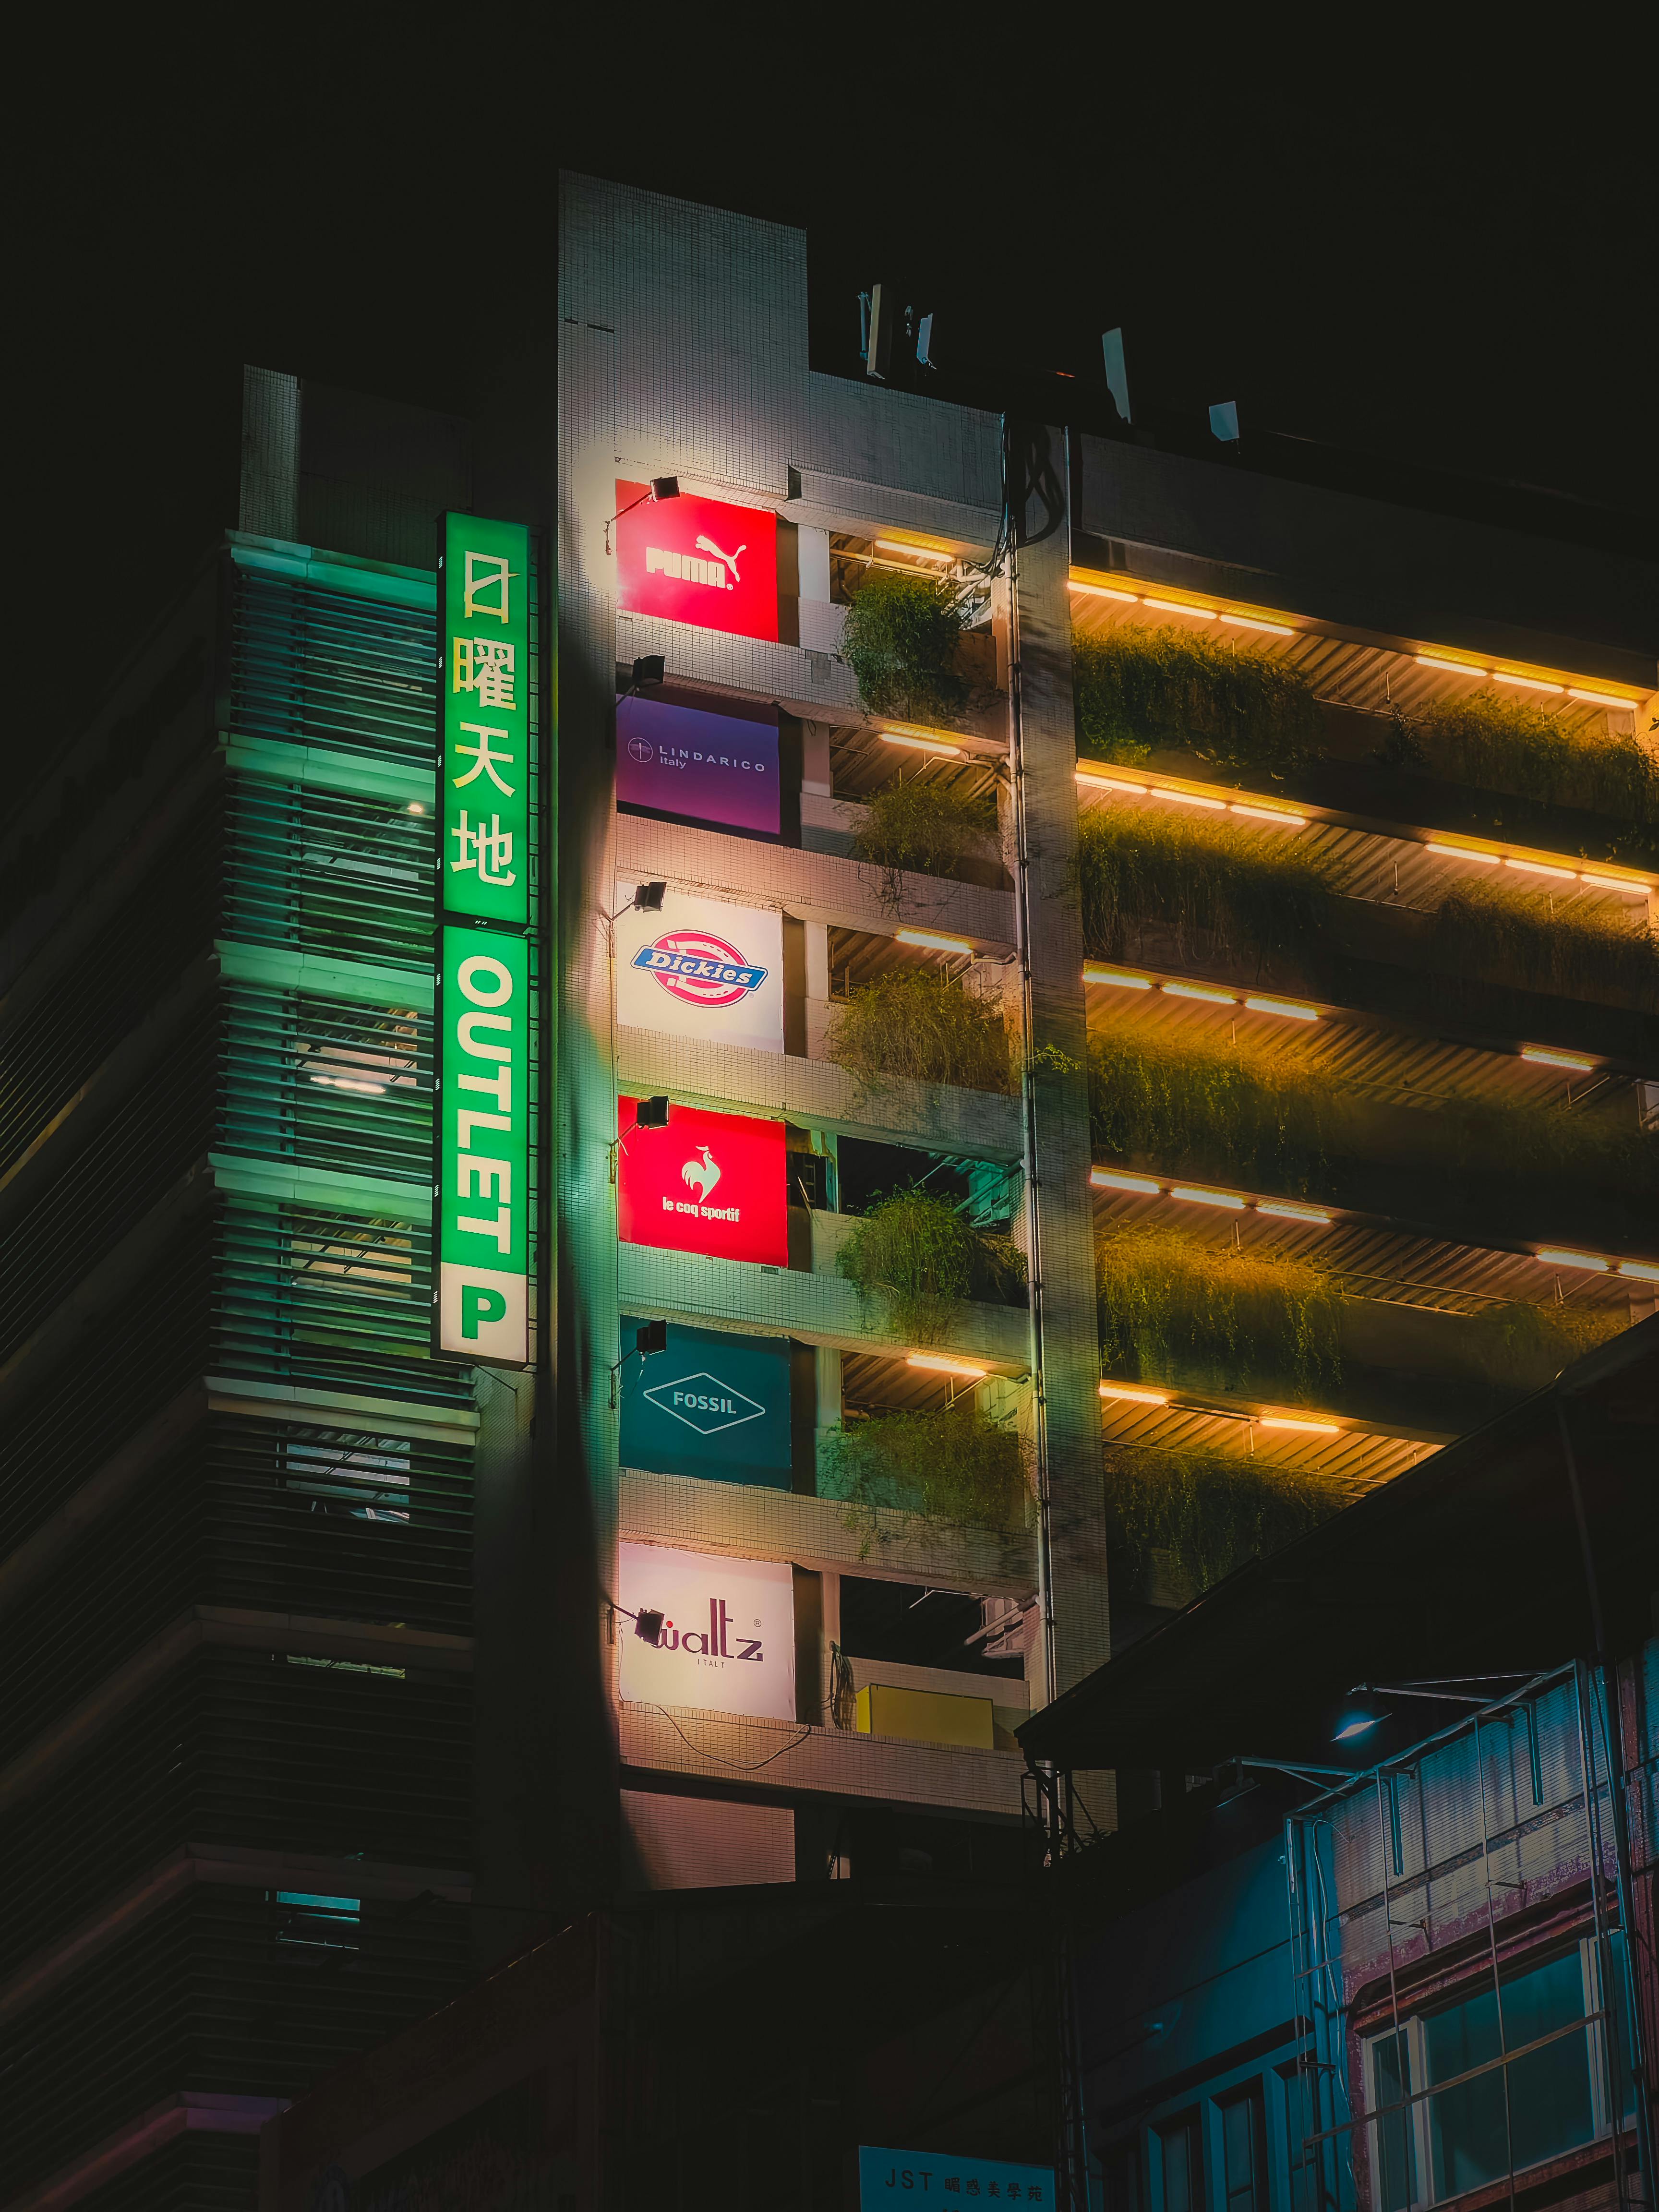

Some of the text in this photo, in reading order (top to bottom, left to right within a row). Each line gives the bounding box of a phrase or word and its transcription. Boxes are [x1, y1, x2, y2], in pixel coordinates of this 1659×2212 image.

[646, 547, 725, 589] PUMA
[451, 551, 520, 887] 日曜天地
[659, 745, 765, 772] LINDARICO
[646, 952, 753, 984] Dickies
[457, 955, 513, 1255] OUTLET
[662, 1196, 740, 1222] le coq sportif
[461, 1285, 506, 1340] P
[673, 1391, 737, 1414] FOSSIL
[697, 1659, 725, 1668] ITALY
[885, 2168, 933, 2191] JST
